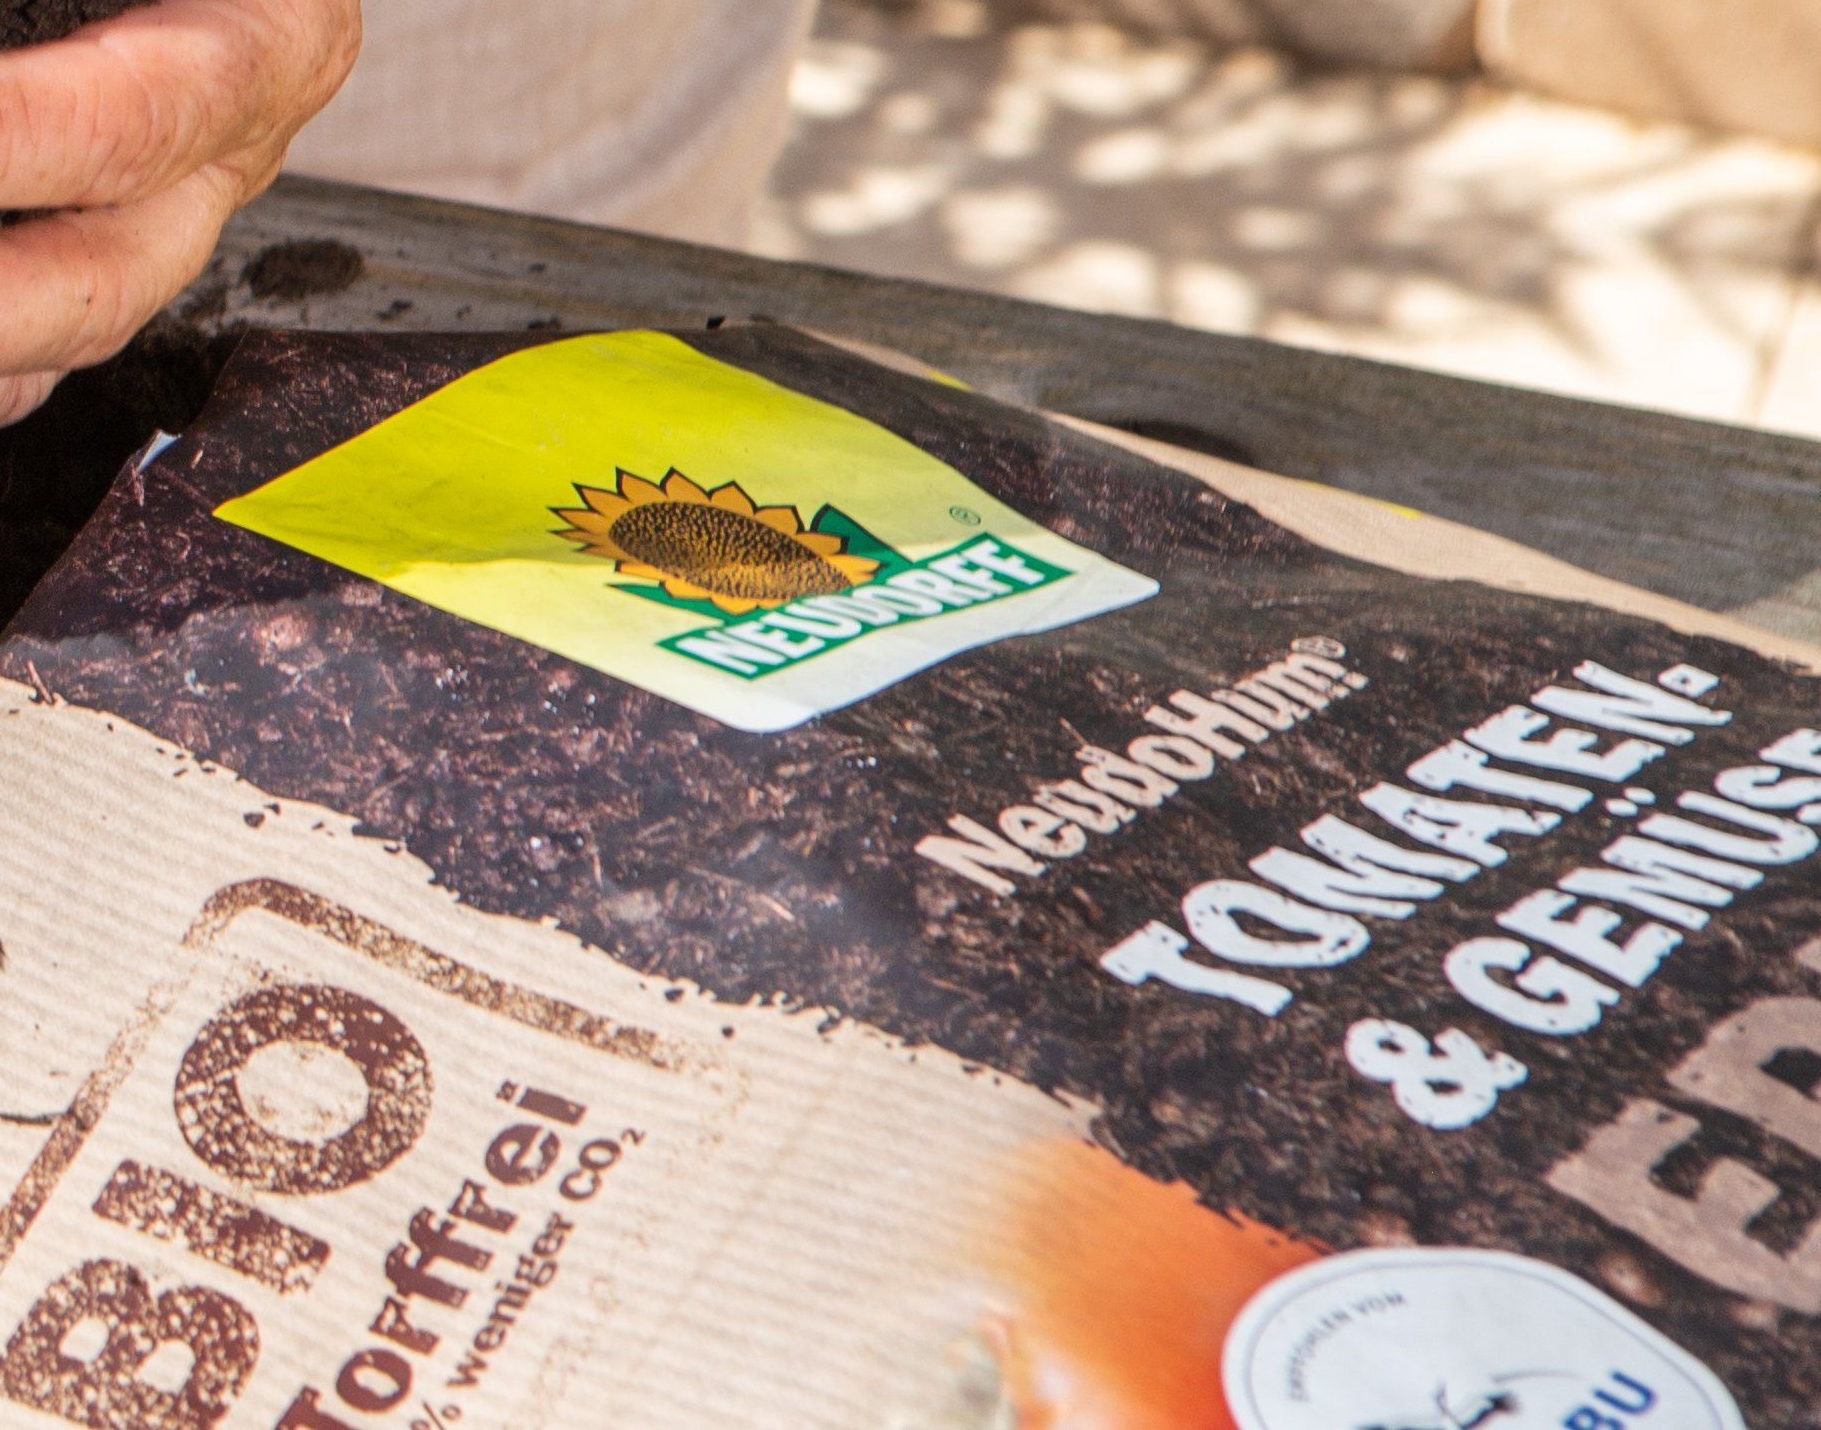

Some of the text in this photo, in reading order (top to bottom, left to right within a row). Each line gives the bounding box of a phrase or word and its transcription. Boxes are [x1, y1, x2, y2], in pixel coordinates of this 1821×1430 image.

[674, 538, 1045, 675] NEUDORFF
[1344, 1018, 1529, 1131] &
[445, 1211, 575, 1390] weniger
